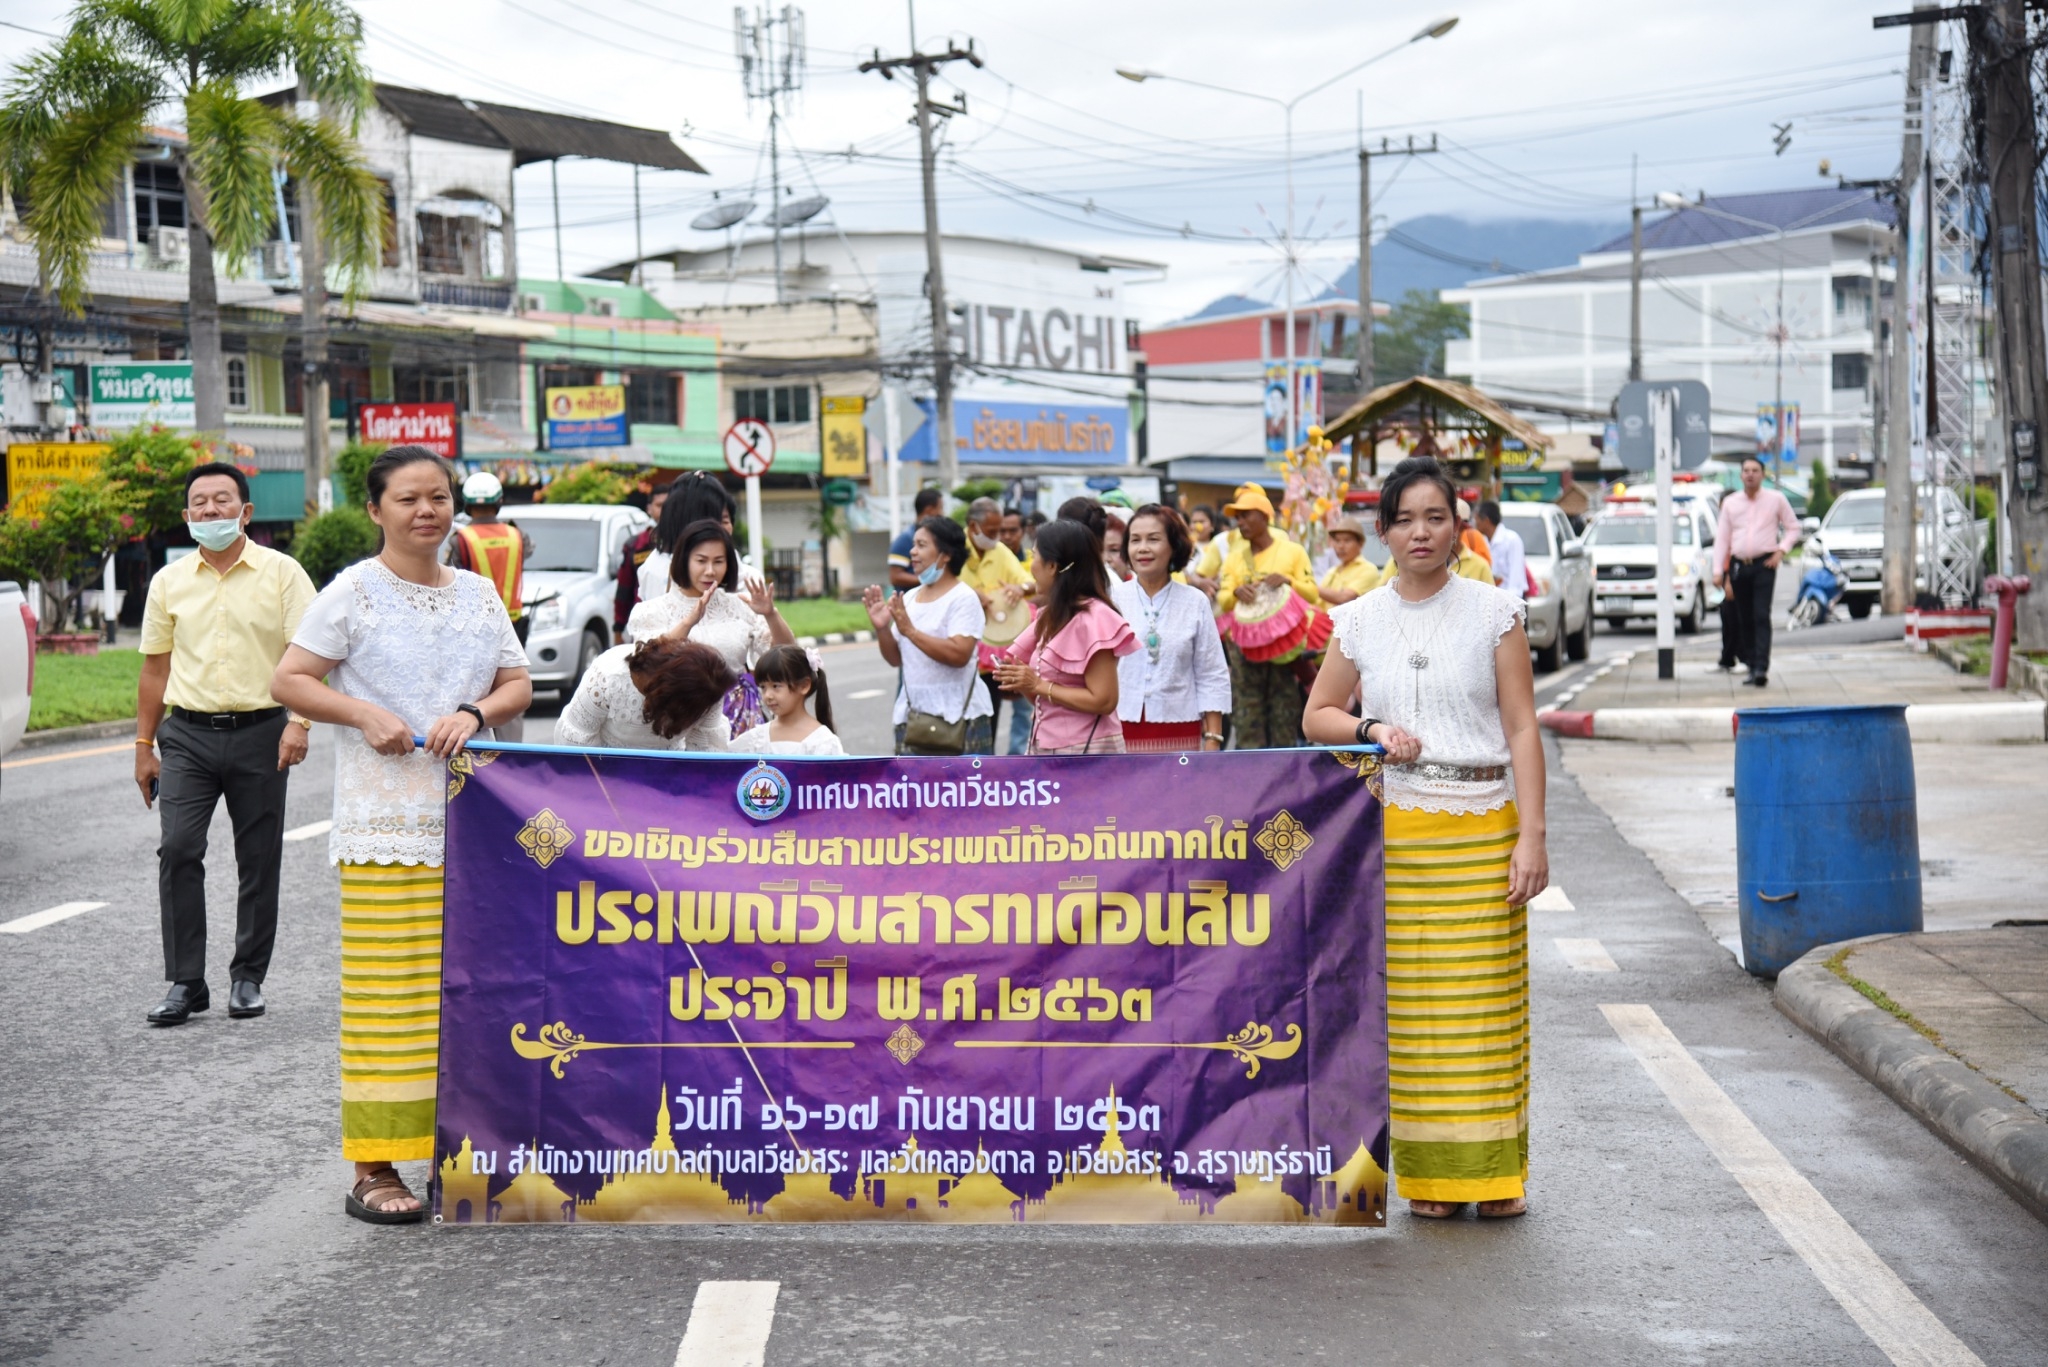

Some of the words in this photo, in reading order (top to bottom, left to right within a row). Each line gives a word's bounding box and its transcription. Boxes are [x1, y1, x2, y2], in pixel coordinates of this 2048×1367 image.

[948, 304, 1116, 370] HITACHI
[798, 774, 1060, 810] เทศบาลตำบลเวียงสระ
[584, 815, 1248, 868] ขอเชิญร่วมสืบสานประเพณีท้องถิ่นภาคใต้
[555, 875, 1271, 946] ประเพณีวันสารทเดือนสิบ
[669, 955, 848, 1021] ประจำปี
[877, 973, 1153, 1021] พ.ศ.๒๕๖๓
[675, 1077, 743, 1130] วันที่
[761, 1096, 879, 1131] ๑๖-๑๗
[898, 1086, 1035, 1131] กันยายน
[1054, 1096, 1160, 1131] ๒๕๖๓
[472, 1150, 496, 1174] ณ
[508, 1142, 849, 1175] สำนักงานเทศบาลตำบลเวียงสระ
[861, 1143, 1035, 1175] และวัดคลองตาล
[1048, 1143, 1163, 1175] อ.เวียงสระ
[1174, 1144, 1332, 1182] จ.สุราษฎร์ธานี
